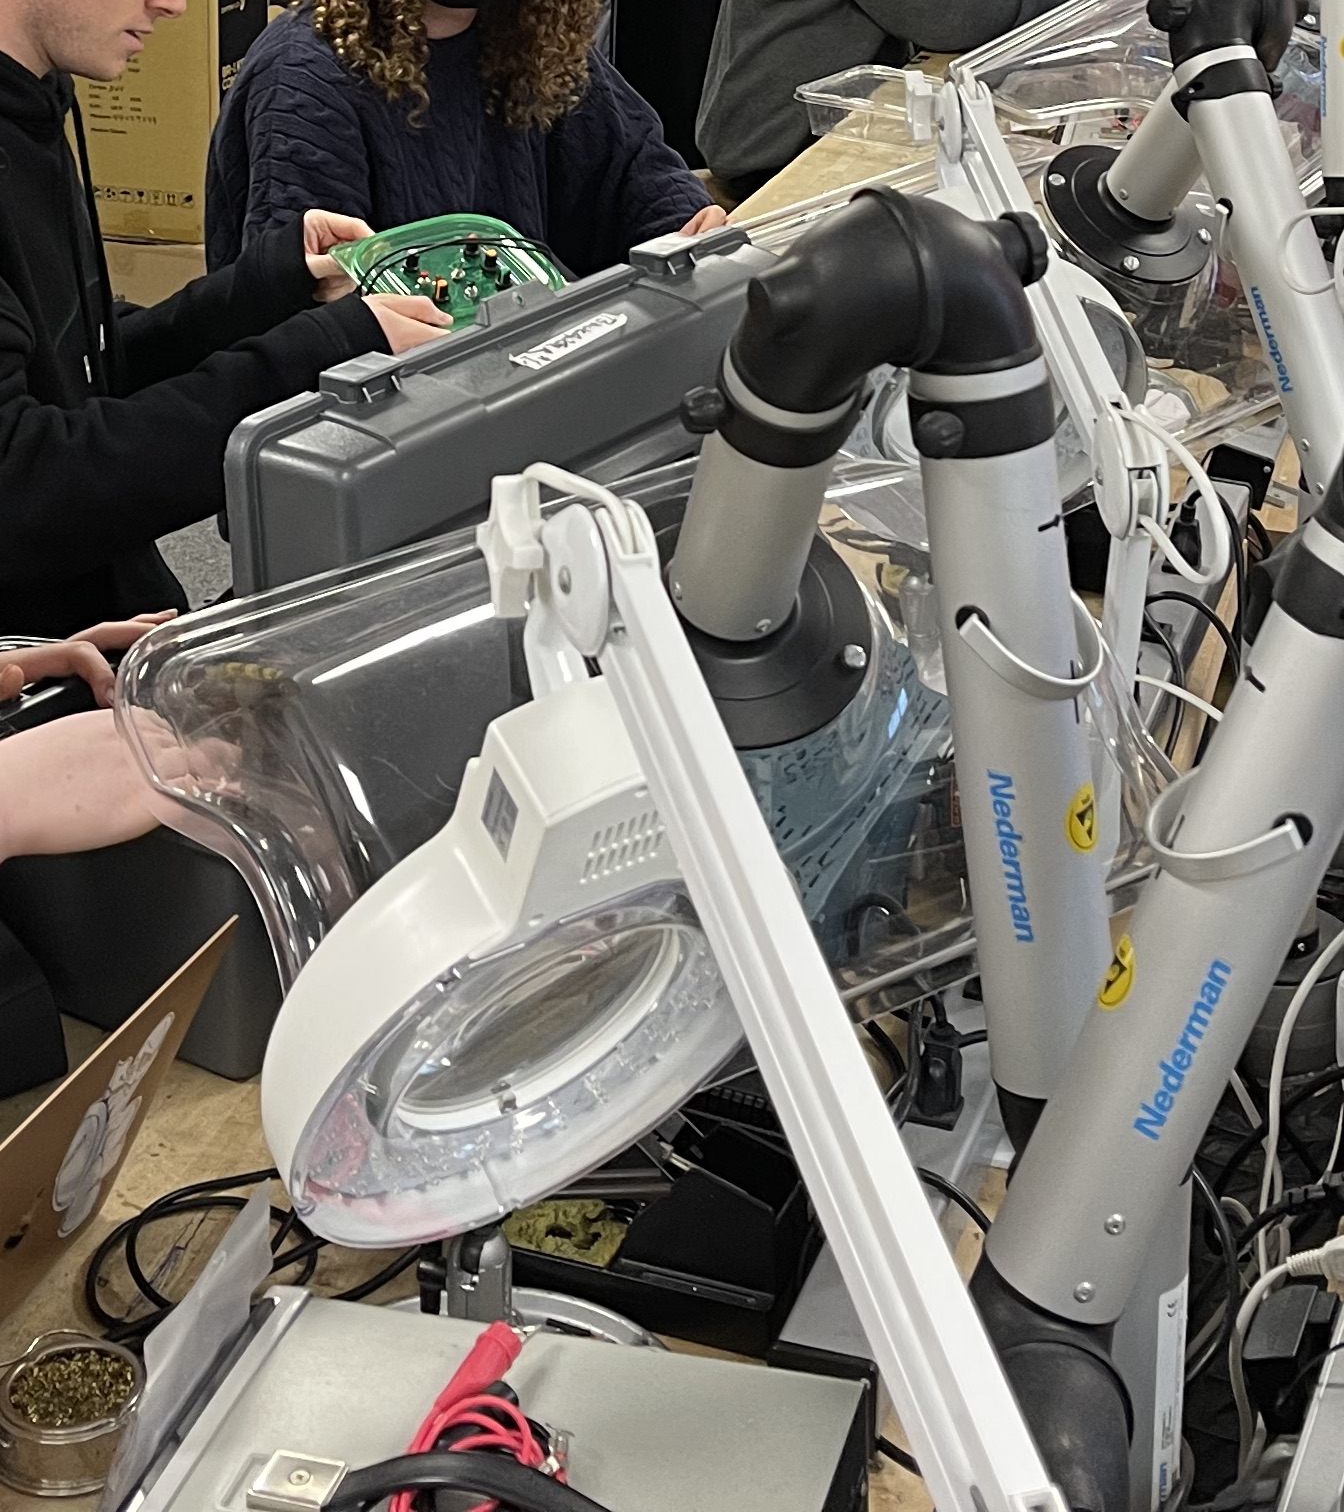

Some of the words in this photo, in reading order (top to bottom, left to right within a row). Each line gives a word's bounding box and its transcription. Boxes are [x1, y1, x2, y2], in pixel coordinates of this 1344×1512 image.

[1250, 285, 1293, 393] Nederman
[985, 768, 1035, 944] Nederman
[1133, 957, 1233, 1142] Nederman
